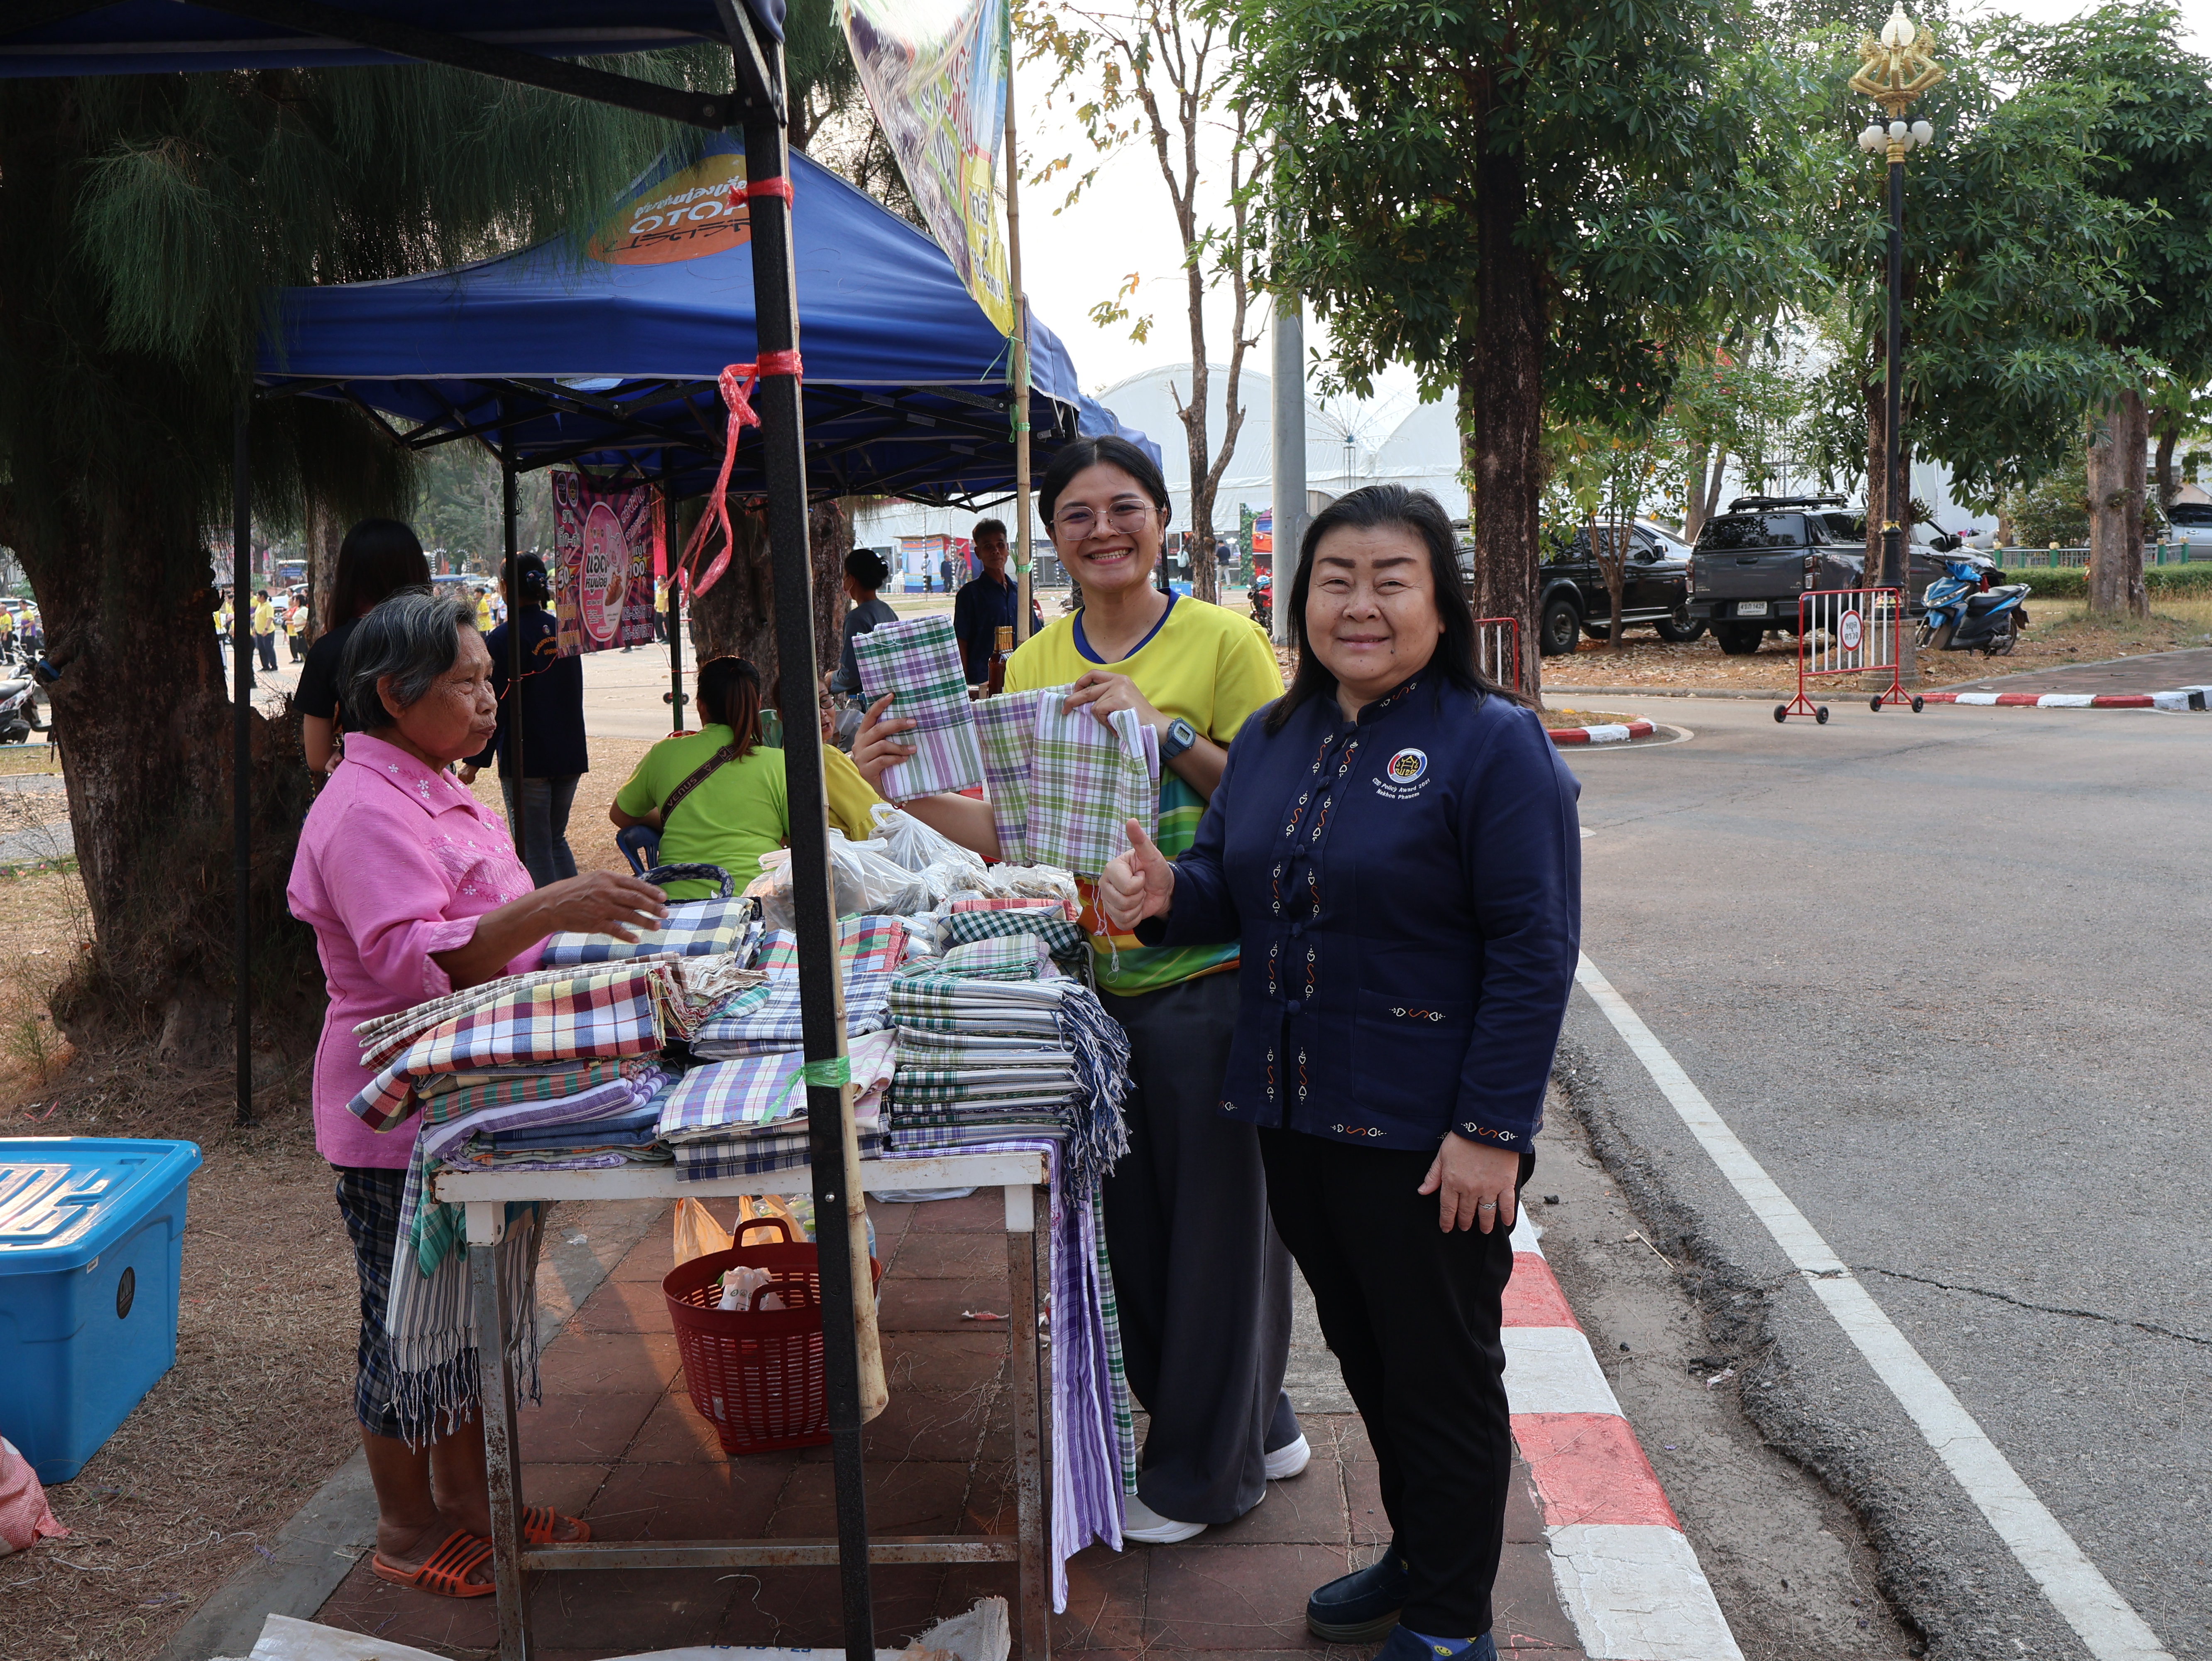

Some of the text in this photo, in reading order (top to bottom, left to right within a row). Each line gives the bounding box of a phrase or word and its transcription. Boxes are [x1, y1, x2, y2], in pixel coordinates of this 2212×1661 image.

[667, 777, 697, 807] VENUS
[1372, 777, 1381, 786] CDD
[1381, 783, 1397, 792] Policy
[1419, 778, 1431, 789] 2021
[1376, 788, 1395, 799] Nakhon
